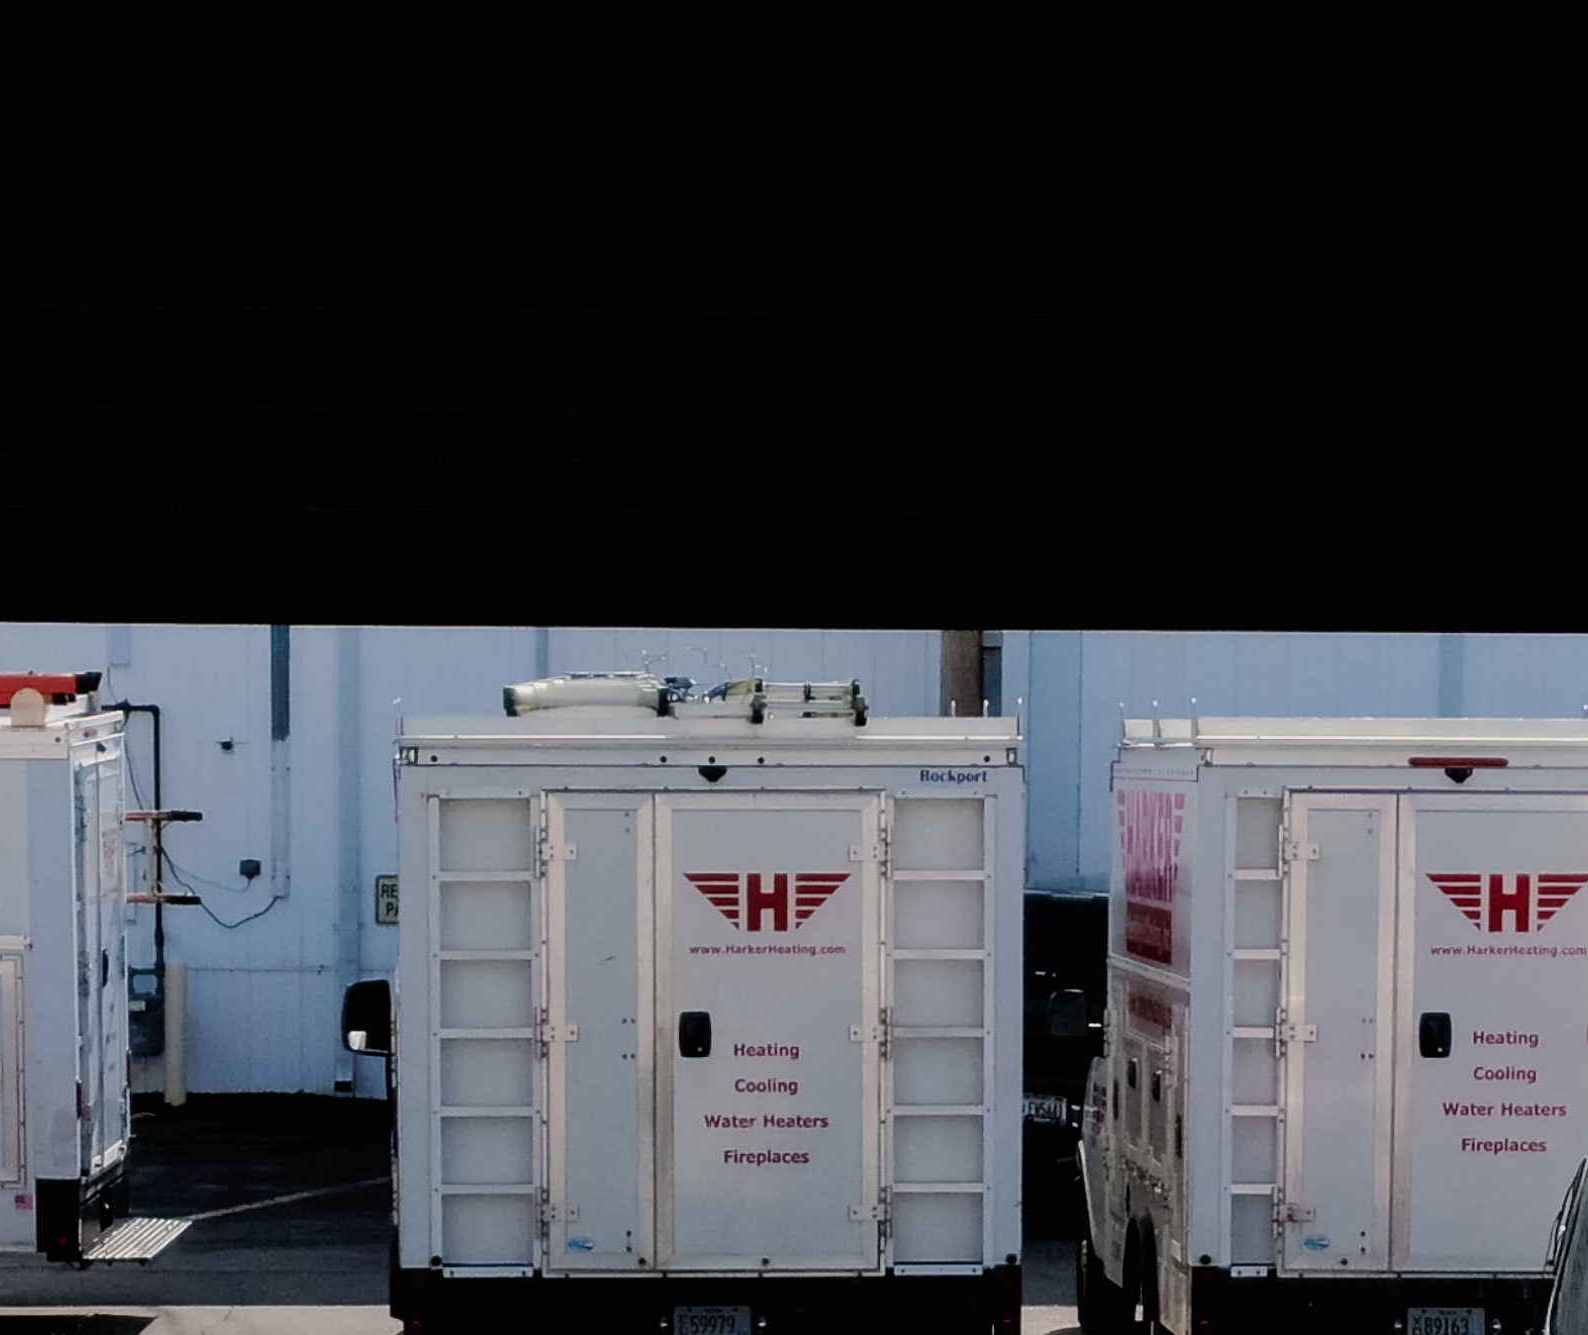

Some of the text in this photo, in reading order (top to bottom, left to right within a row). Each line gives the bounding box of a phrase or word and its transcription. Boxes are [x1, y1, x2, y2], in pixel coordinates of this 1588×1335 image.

[920, 769, 988, 785] Rockport
[747, 873, 788, 932] H
[1488, 874, 1530, 933] H
[689, 944, 846, 956] www.HarkerHeating.com
[1430, 945, 1587, 957] www.HarkerHeating.com
[1473, 1031, 1539, 1048] Heating
[733, 1043, 800, 1060] Heating
[1473, 1066, 1537, 1084] Cooling
[734, 1078, 799, 1096] Cooling
[1442, 1102, 1567, 1117] Water Heaters
[704, 1114, 829, 1128] Water Heaters
[1461, 1138, 1547, 1155] Fireplaces
[723, 1149, 810, 1167] Fireplaces
